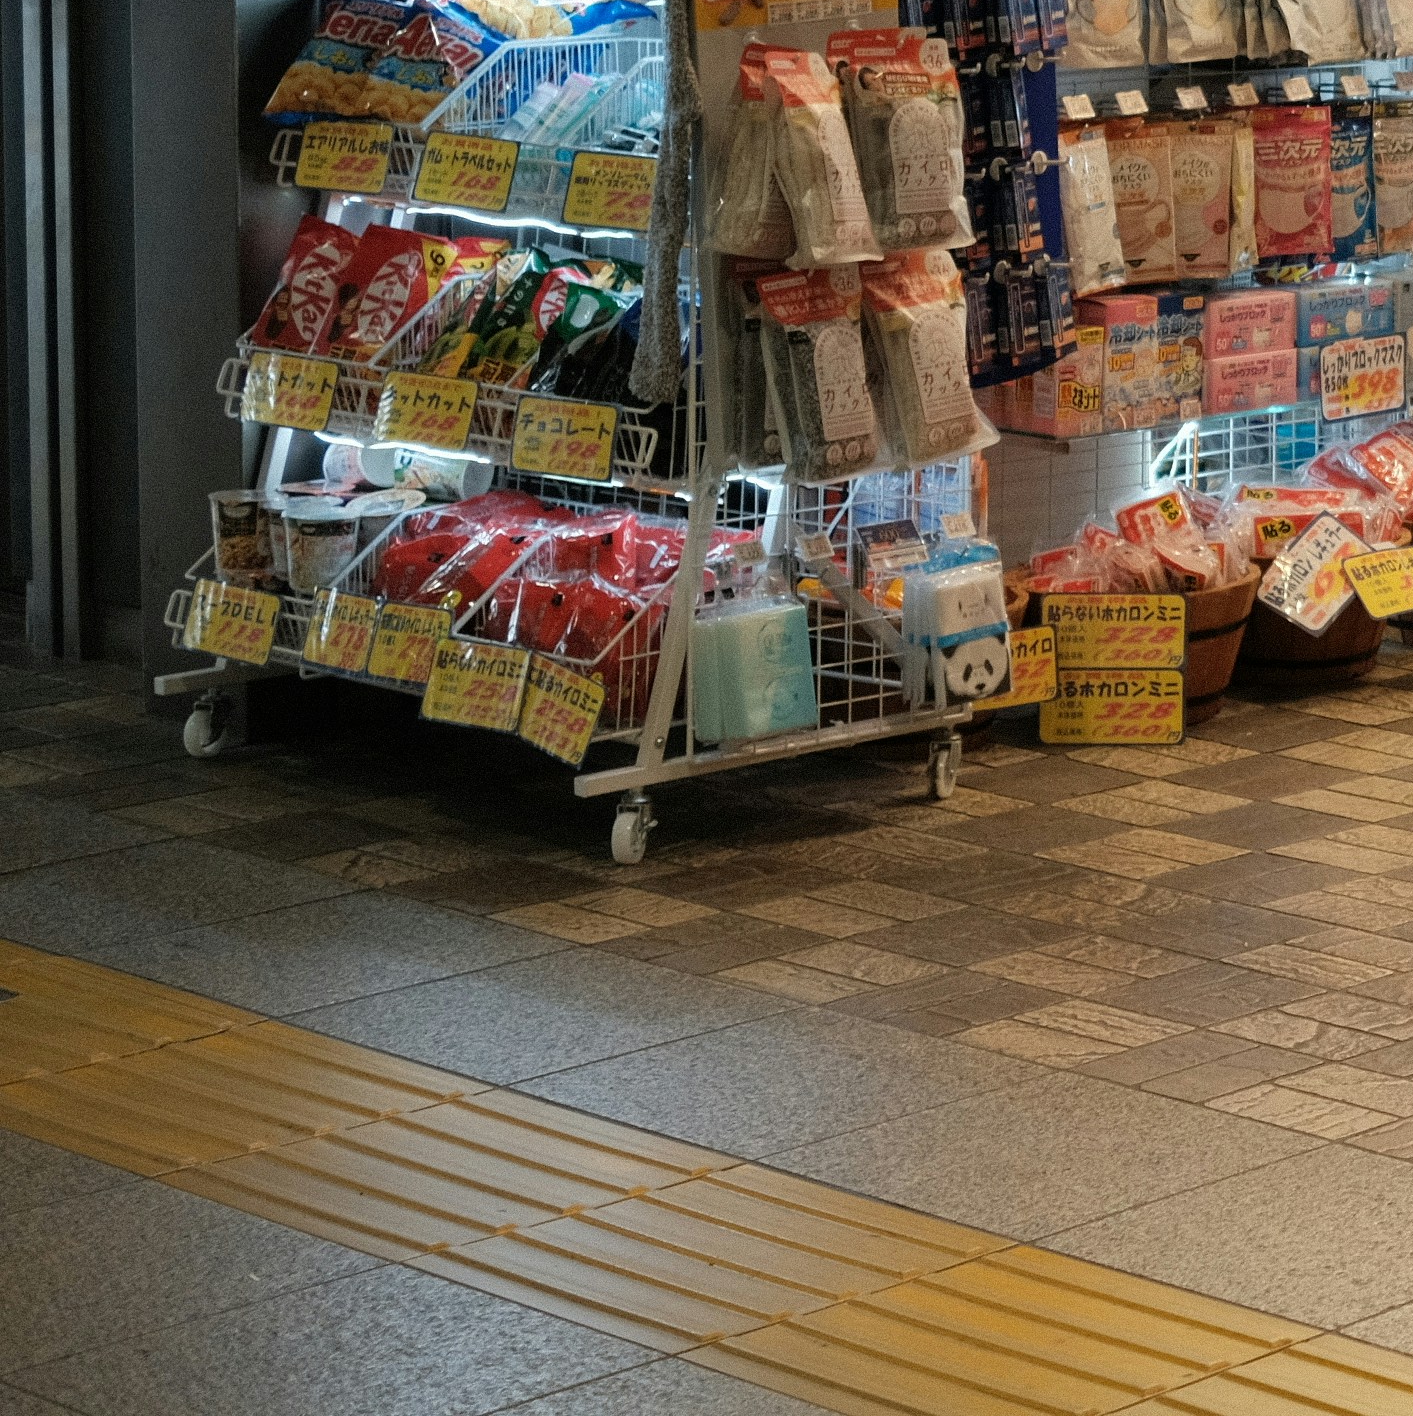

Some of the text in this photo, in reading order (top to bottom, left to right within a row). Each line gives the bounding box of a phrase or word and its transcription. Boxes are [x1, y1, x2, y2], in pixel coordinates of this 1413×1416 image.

[1256, 139, 1323, 161] 三次元
[899, 160, 950, 177] カイロ
[1321, 342, 1404, 375] しっかりブロックマスク
[1350, 368, 1401, 399] 398
[519, 413, 612, 439] チョコレート
[1261, 520, 1292, 539] 貼る
[1047, 605, 1182, 623] 貼らないホカロンミニ
